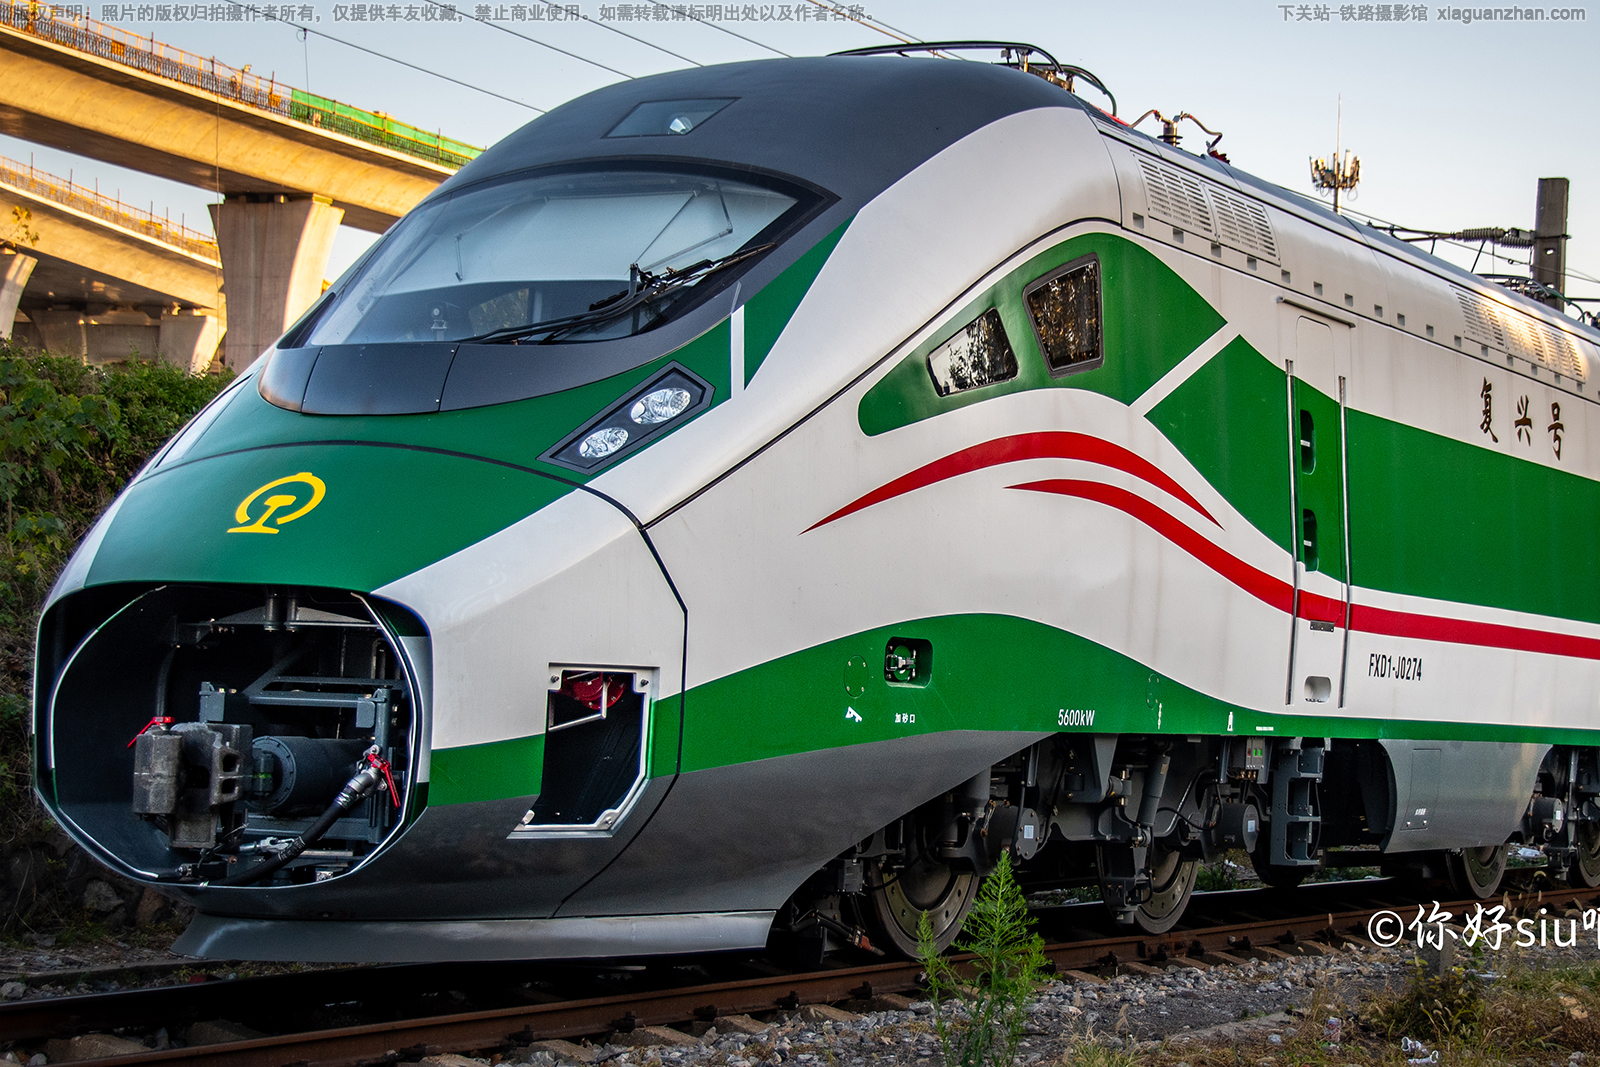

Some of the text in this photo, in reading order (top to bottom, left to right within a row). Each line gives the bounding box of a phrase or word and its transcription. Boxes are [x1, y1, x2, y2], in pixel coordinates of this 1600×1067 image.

[1480, 377, 1564, 461] 复兴号
[1368, 653, 1423, 681] FXD1-J0274
[1057, 708, 1095, 726] 5600kW
